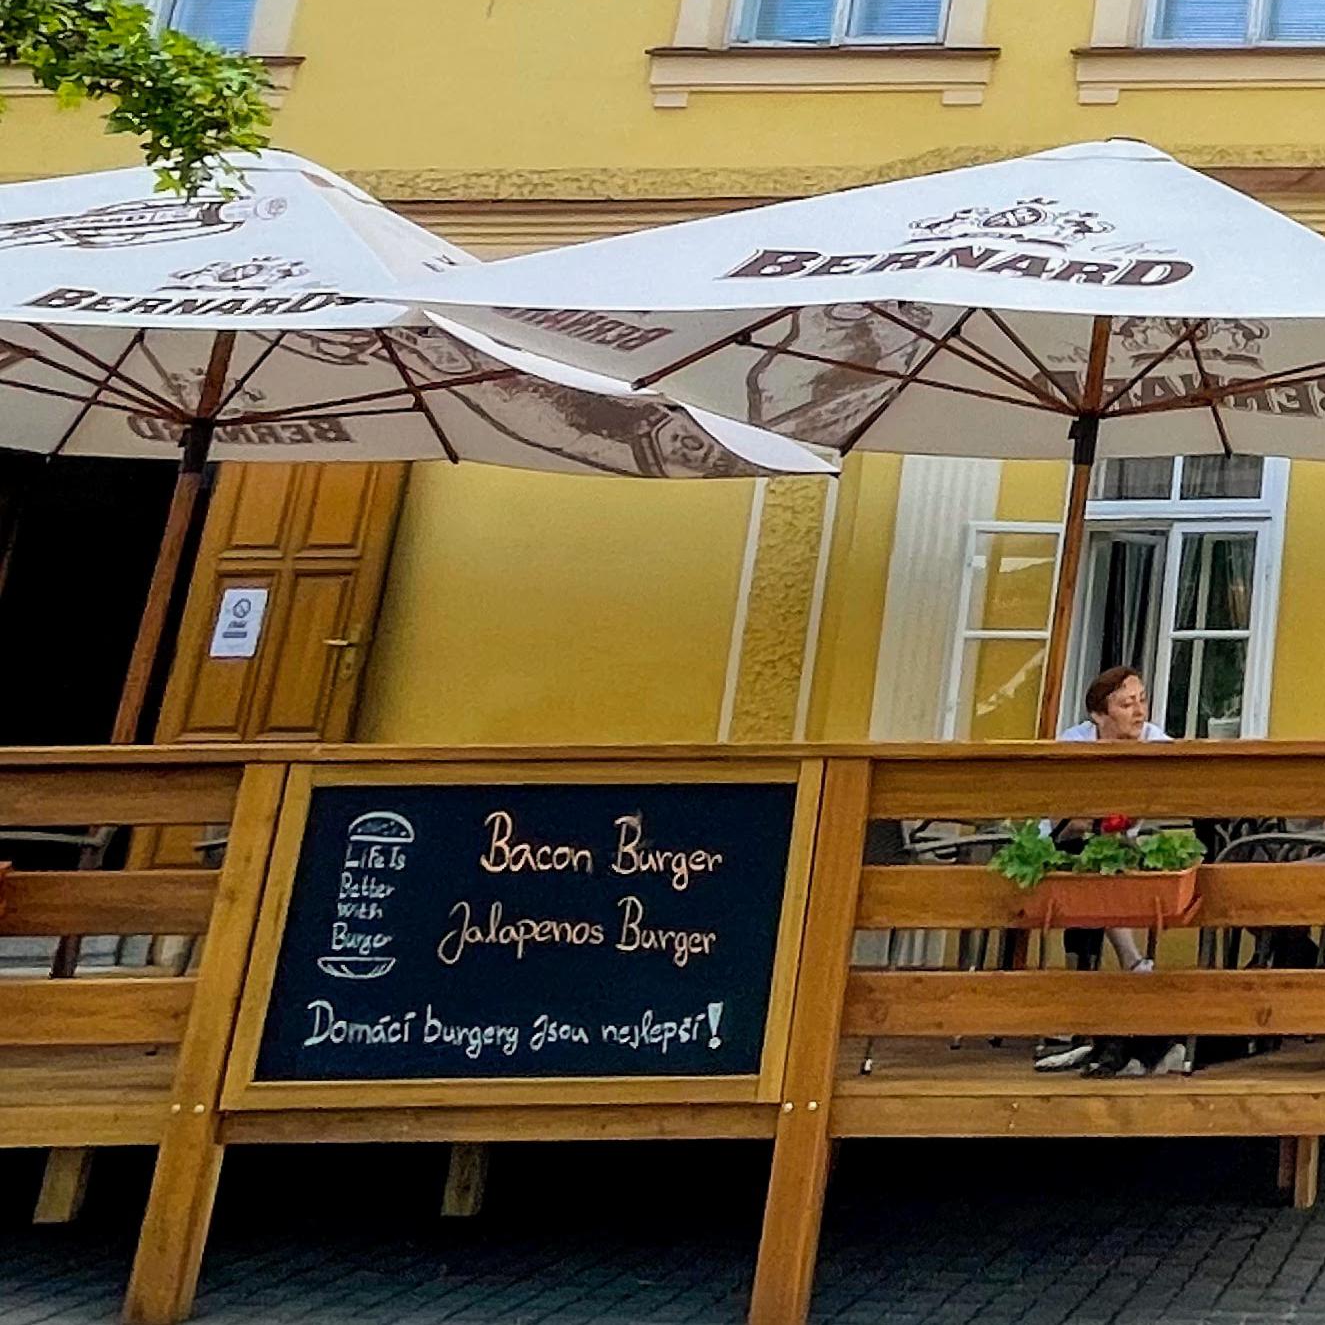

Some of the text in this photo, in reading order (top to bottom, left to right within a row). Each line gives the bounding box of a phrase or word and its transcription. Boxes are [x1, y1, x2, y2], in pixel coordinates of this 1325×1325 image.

[722, 244, 1195, 287] BERNARD
[22, 287, 338, 315] BERNARD
[480, 810, 723, 891] Bacon Burger
[437, 895, 717, 968] Jalapenos Burger
[303, 999, 417, 1049] Domácí
[423, 1003, 520, 1060] burgery
